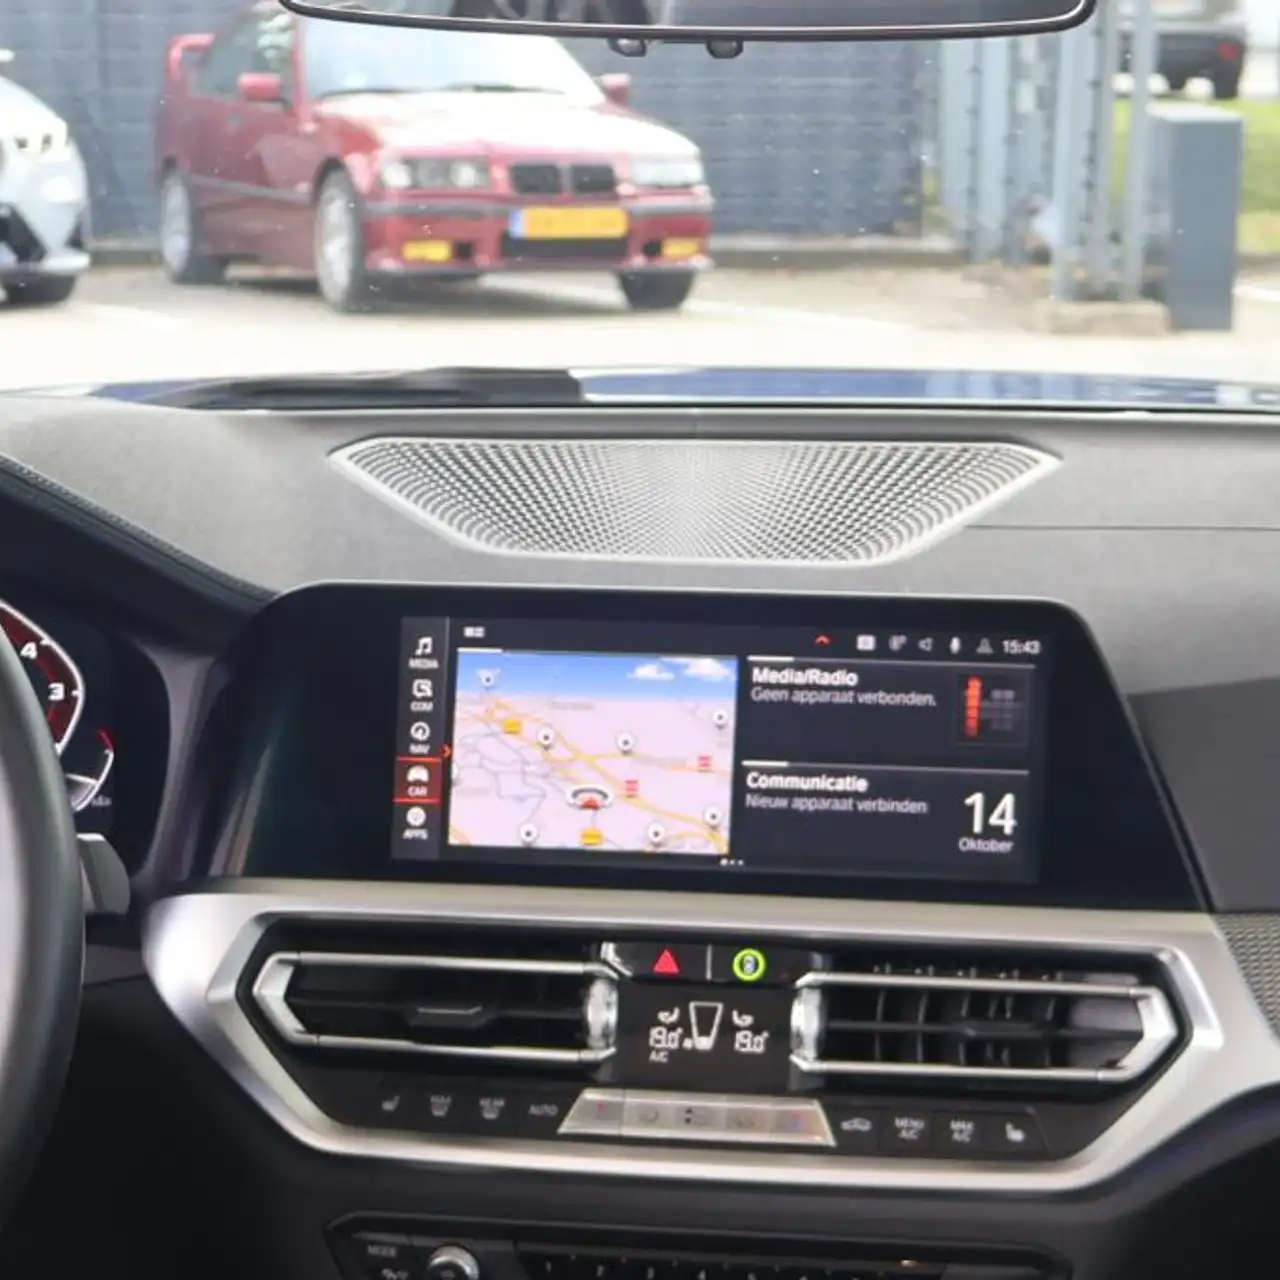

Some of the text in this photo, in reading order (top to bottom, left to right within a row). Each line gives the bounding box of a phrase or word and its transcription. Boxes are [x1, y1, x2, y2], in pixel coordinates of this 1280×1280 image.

[21, 642, 37, 660] 4
[1001, 638, 1042, 655] 15:43
[409, 659, 439, 670] MEDIA
[751, 666, 859, 687] Media/Radio
[48, 682, 66, 701] 3
[750, 686, 790, 704] Geen
[791, 688, 854, 706] apparaat
[410, 700, 434, 713] COM
[746, 771, 869, 793] Communicatie
[406, 785, 428, 798] CAR
[745, 793, 928, 814] Nieuw apparaat verbinden
[963, 791, 1018, 836] 14
[403, 828, 429, 841] APPS
[958, 837, 1014, 854] Oktober
[528, 1104, 560, 1117] AUTO
